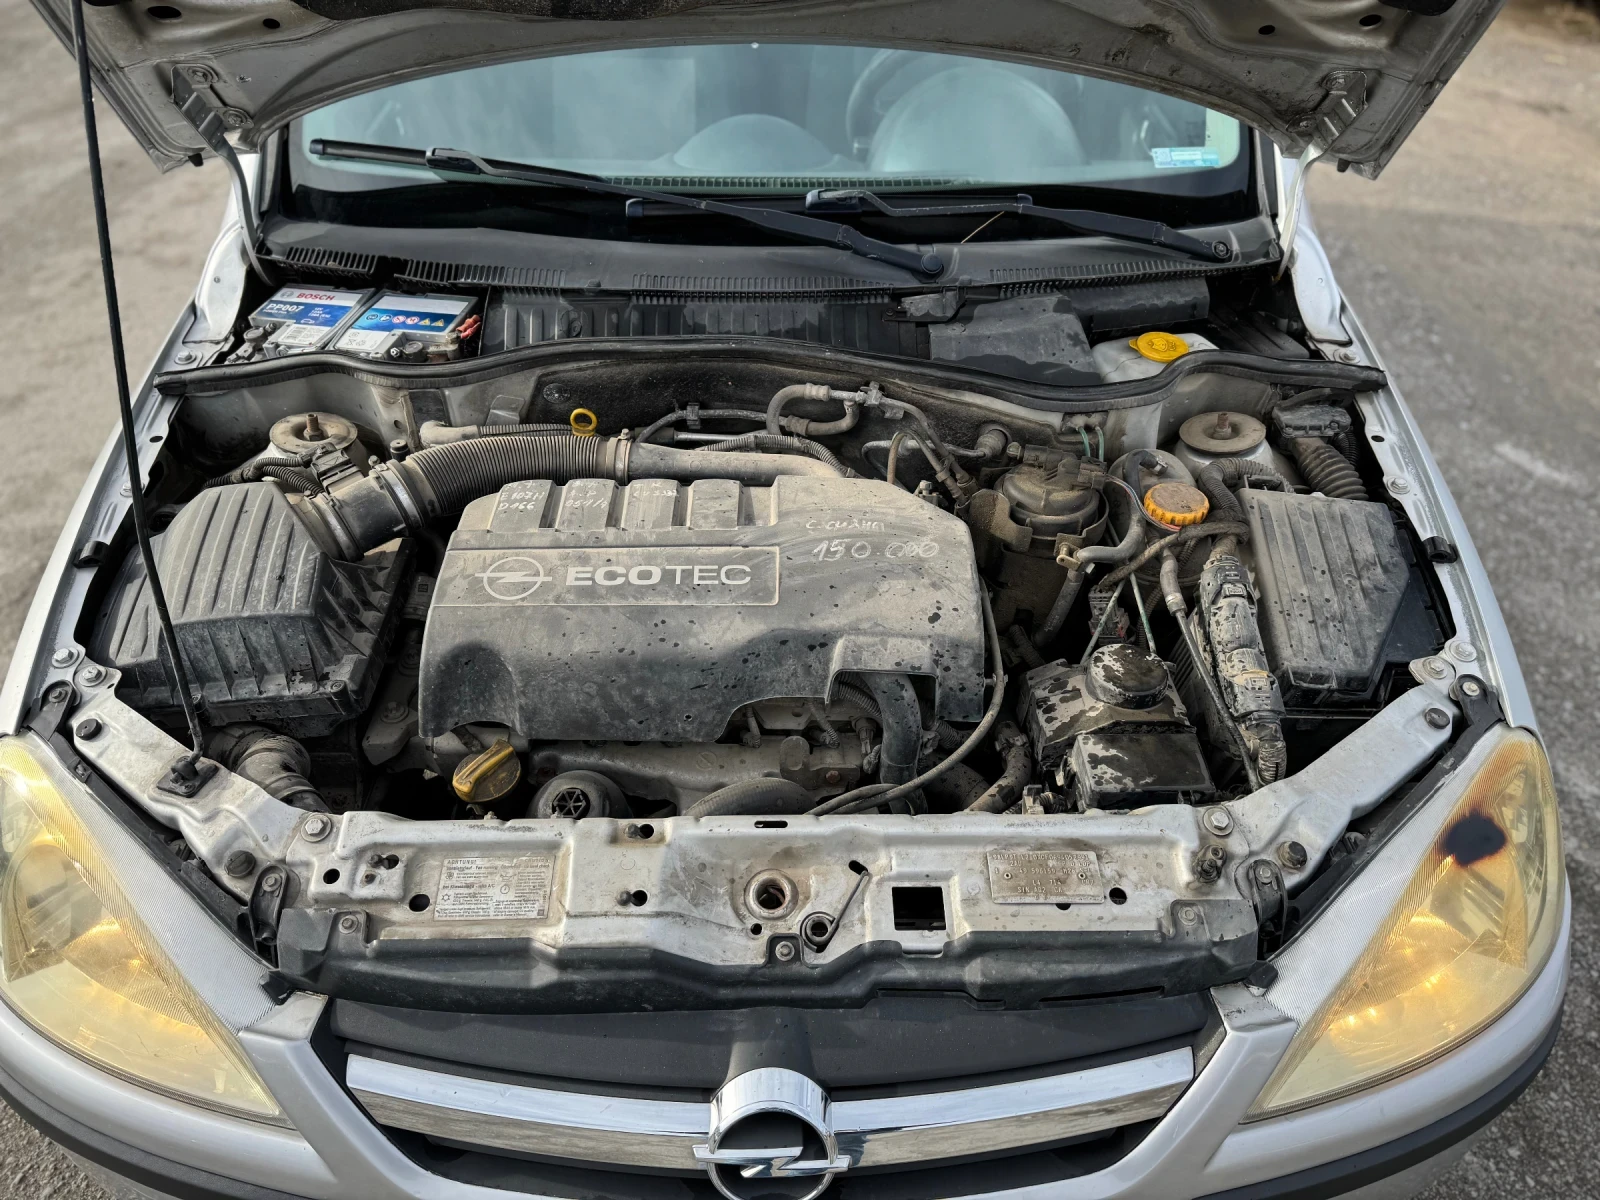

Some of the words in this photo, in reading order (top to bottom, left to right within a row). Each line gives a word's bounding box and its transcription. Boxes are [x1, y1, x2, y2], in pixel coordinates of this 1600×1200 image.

[296, 292, 336, 301] BOSCH
[266, 303, 305, 312] PP007
[566, 565, 752, 586] ECOTEC
